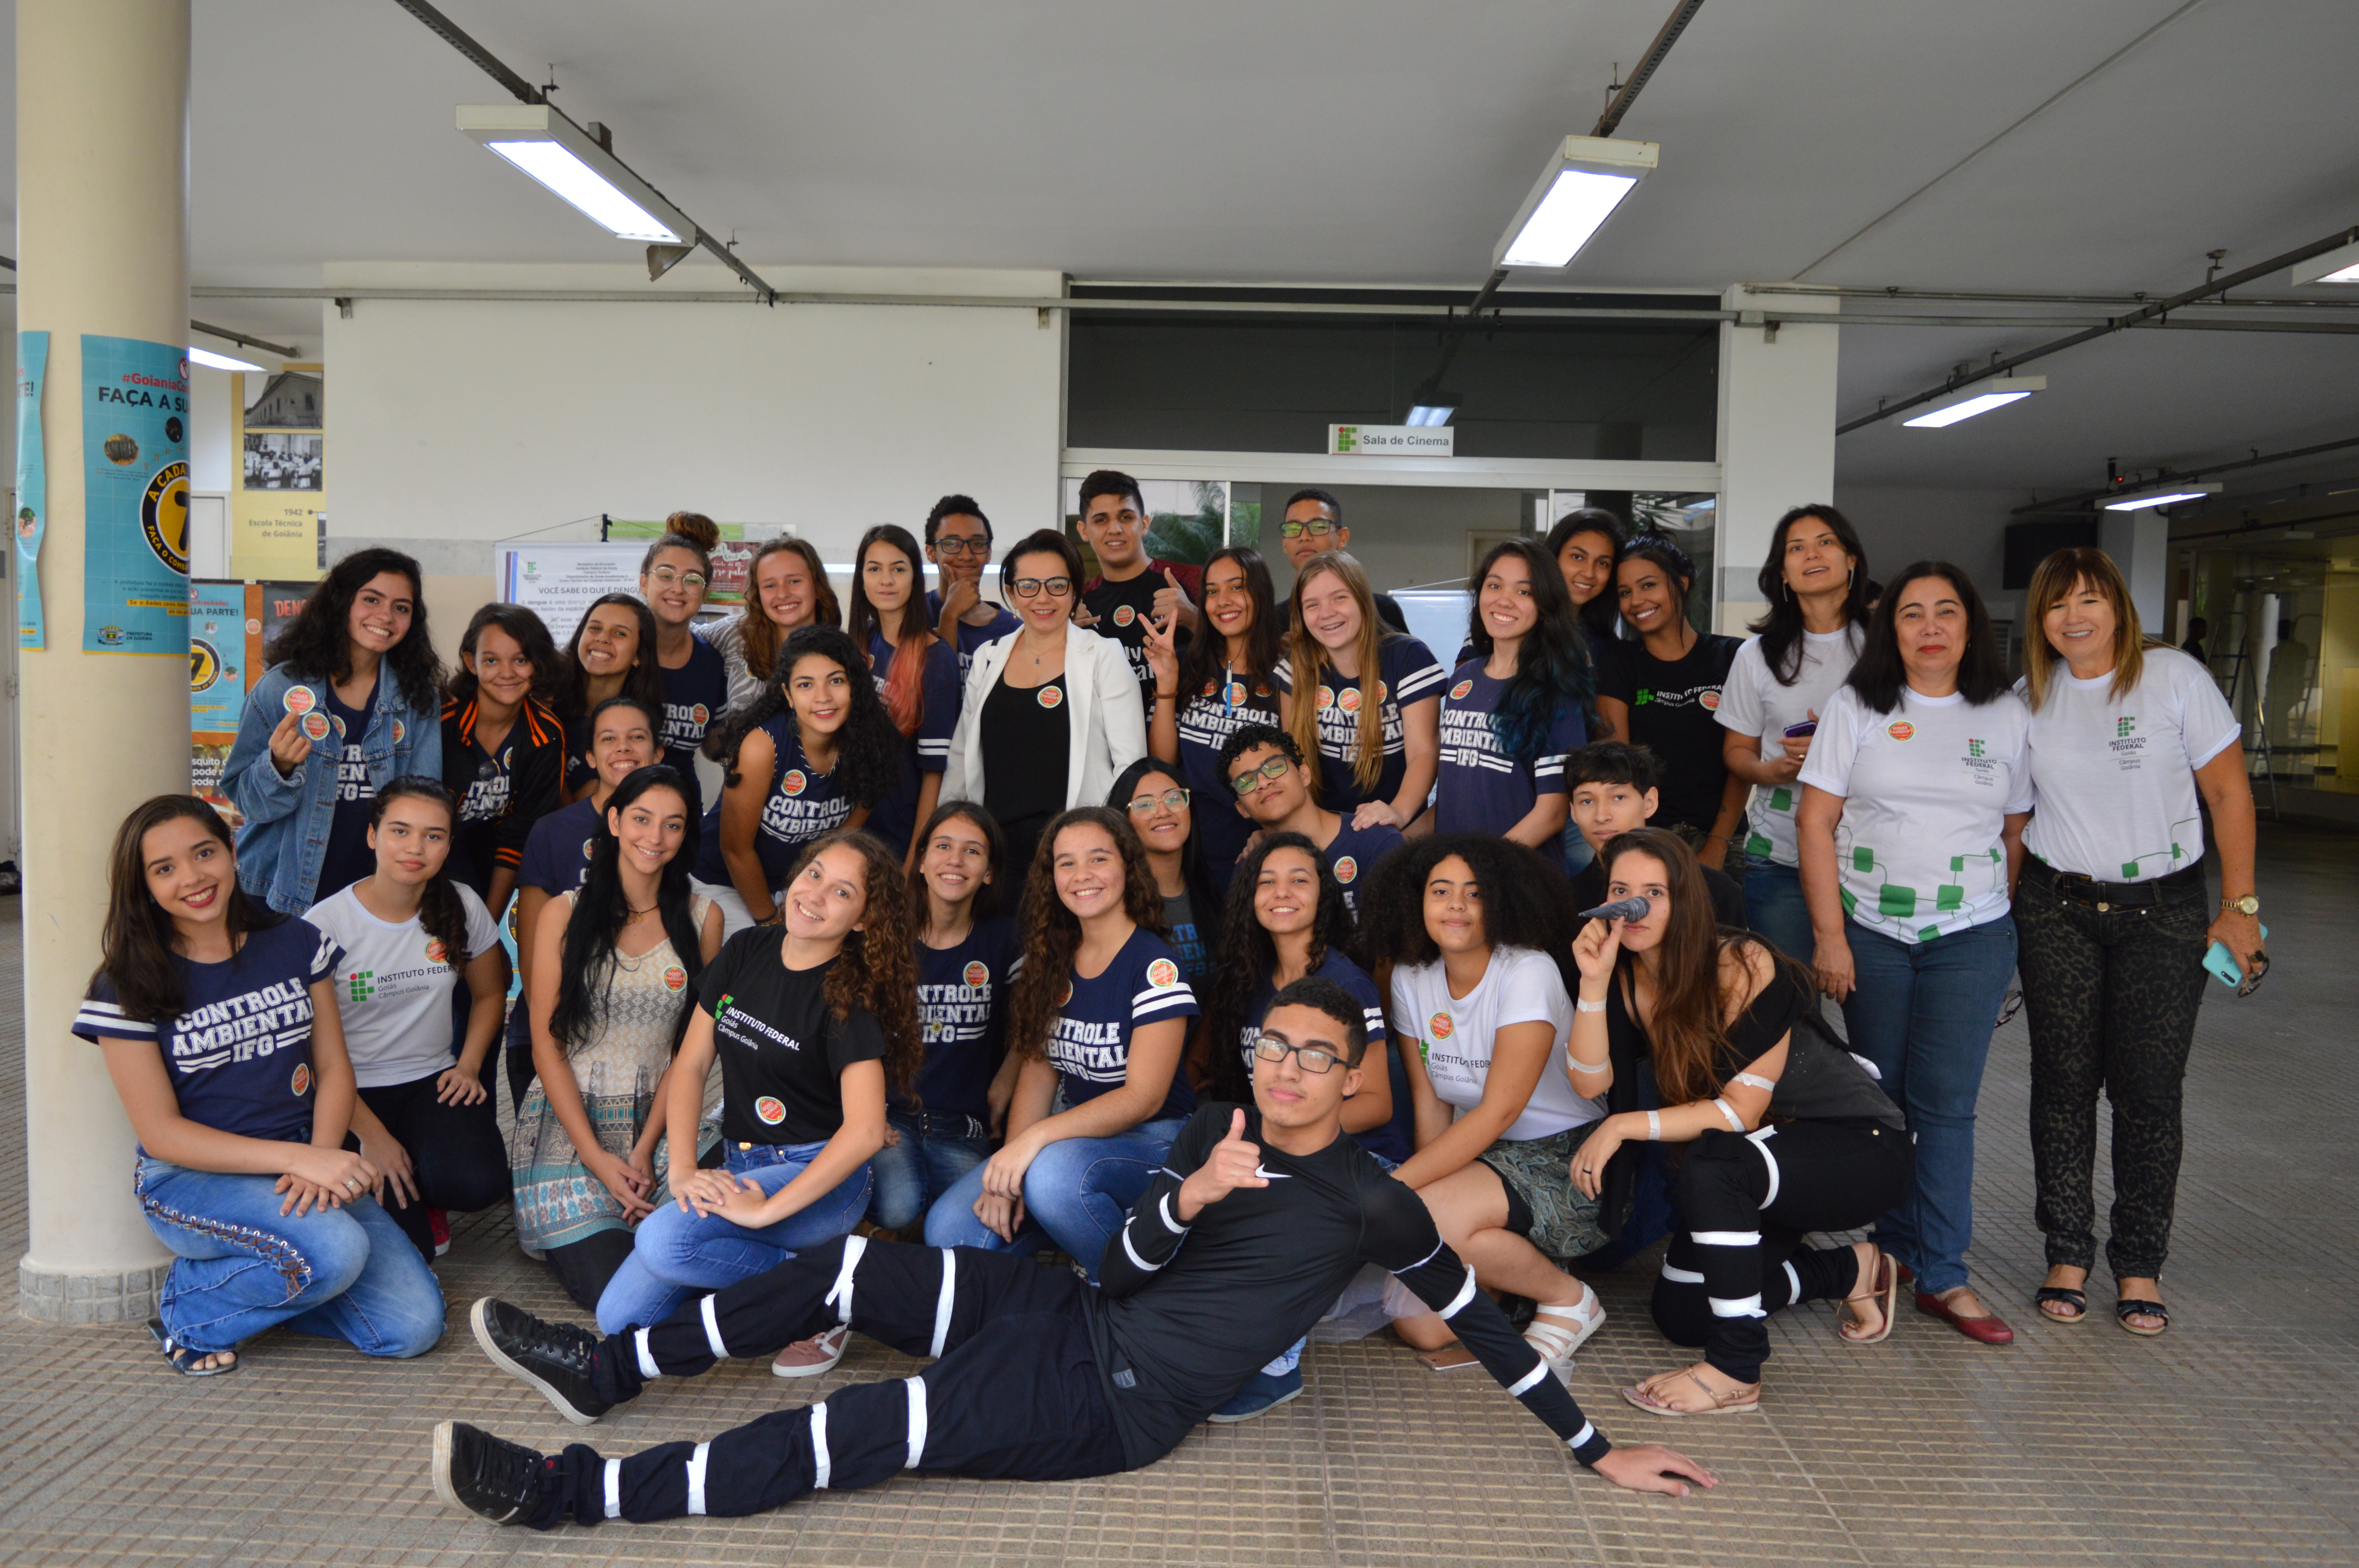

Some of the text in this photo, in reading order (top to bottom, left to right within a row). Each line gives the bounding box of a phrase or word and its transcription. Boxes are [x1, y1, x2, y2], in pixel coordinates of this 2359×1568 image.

[99, 387, 153, 407] FAÇA
[159, 394, 171, 410] A
[1363, 435, 1449, 445] Sala de Cinema
[148, 464, 186, 502] A CADA
[147, 526, 162, 550] FAÇA
[2109, 737, 2146, 747] INSTITUTO
[2113, 743, 2144, 752] FEDERAL
[191, 757, 220, 766] squito
[1457, 748, 1479, 767] IFG
[193, 767, 217, 776] pode
[1154, 965, 1168, 975] GOIÁS
[1155, 969, 1172, 980] DENGUE
[378, 969, 424, 984] INSTITUTO
[378, 984, 396, 992] Goiás
[379, 989, 404, 999] Câmpus
[175, 977, 307, 1032] CONTROLE
[721, 1016, 739, 1029] Goiás
[1434, 1022, 1450, 1031] DENGUE
[726, 1006, 800, 1051] INSTITUTO FEDERAL
[718, 1024, 758, 1050] Câmpus Goiânia
[233, 1034, 274, 1063] IFG
[1431, 1063, 1448, 1071] Goiás
[1431, 1071, 1454, 1080] Câmpus
